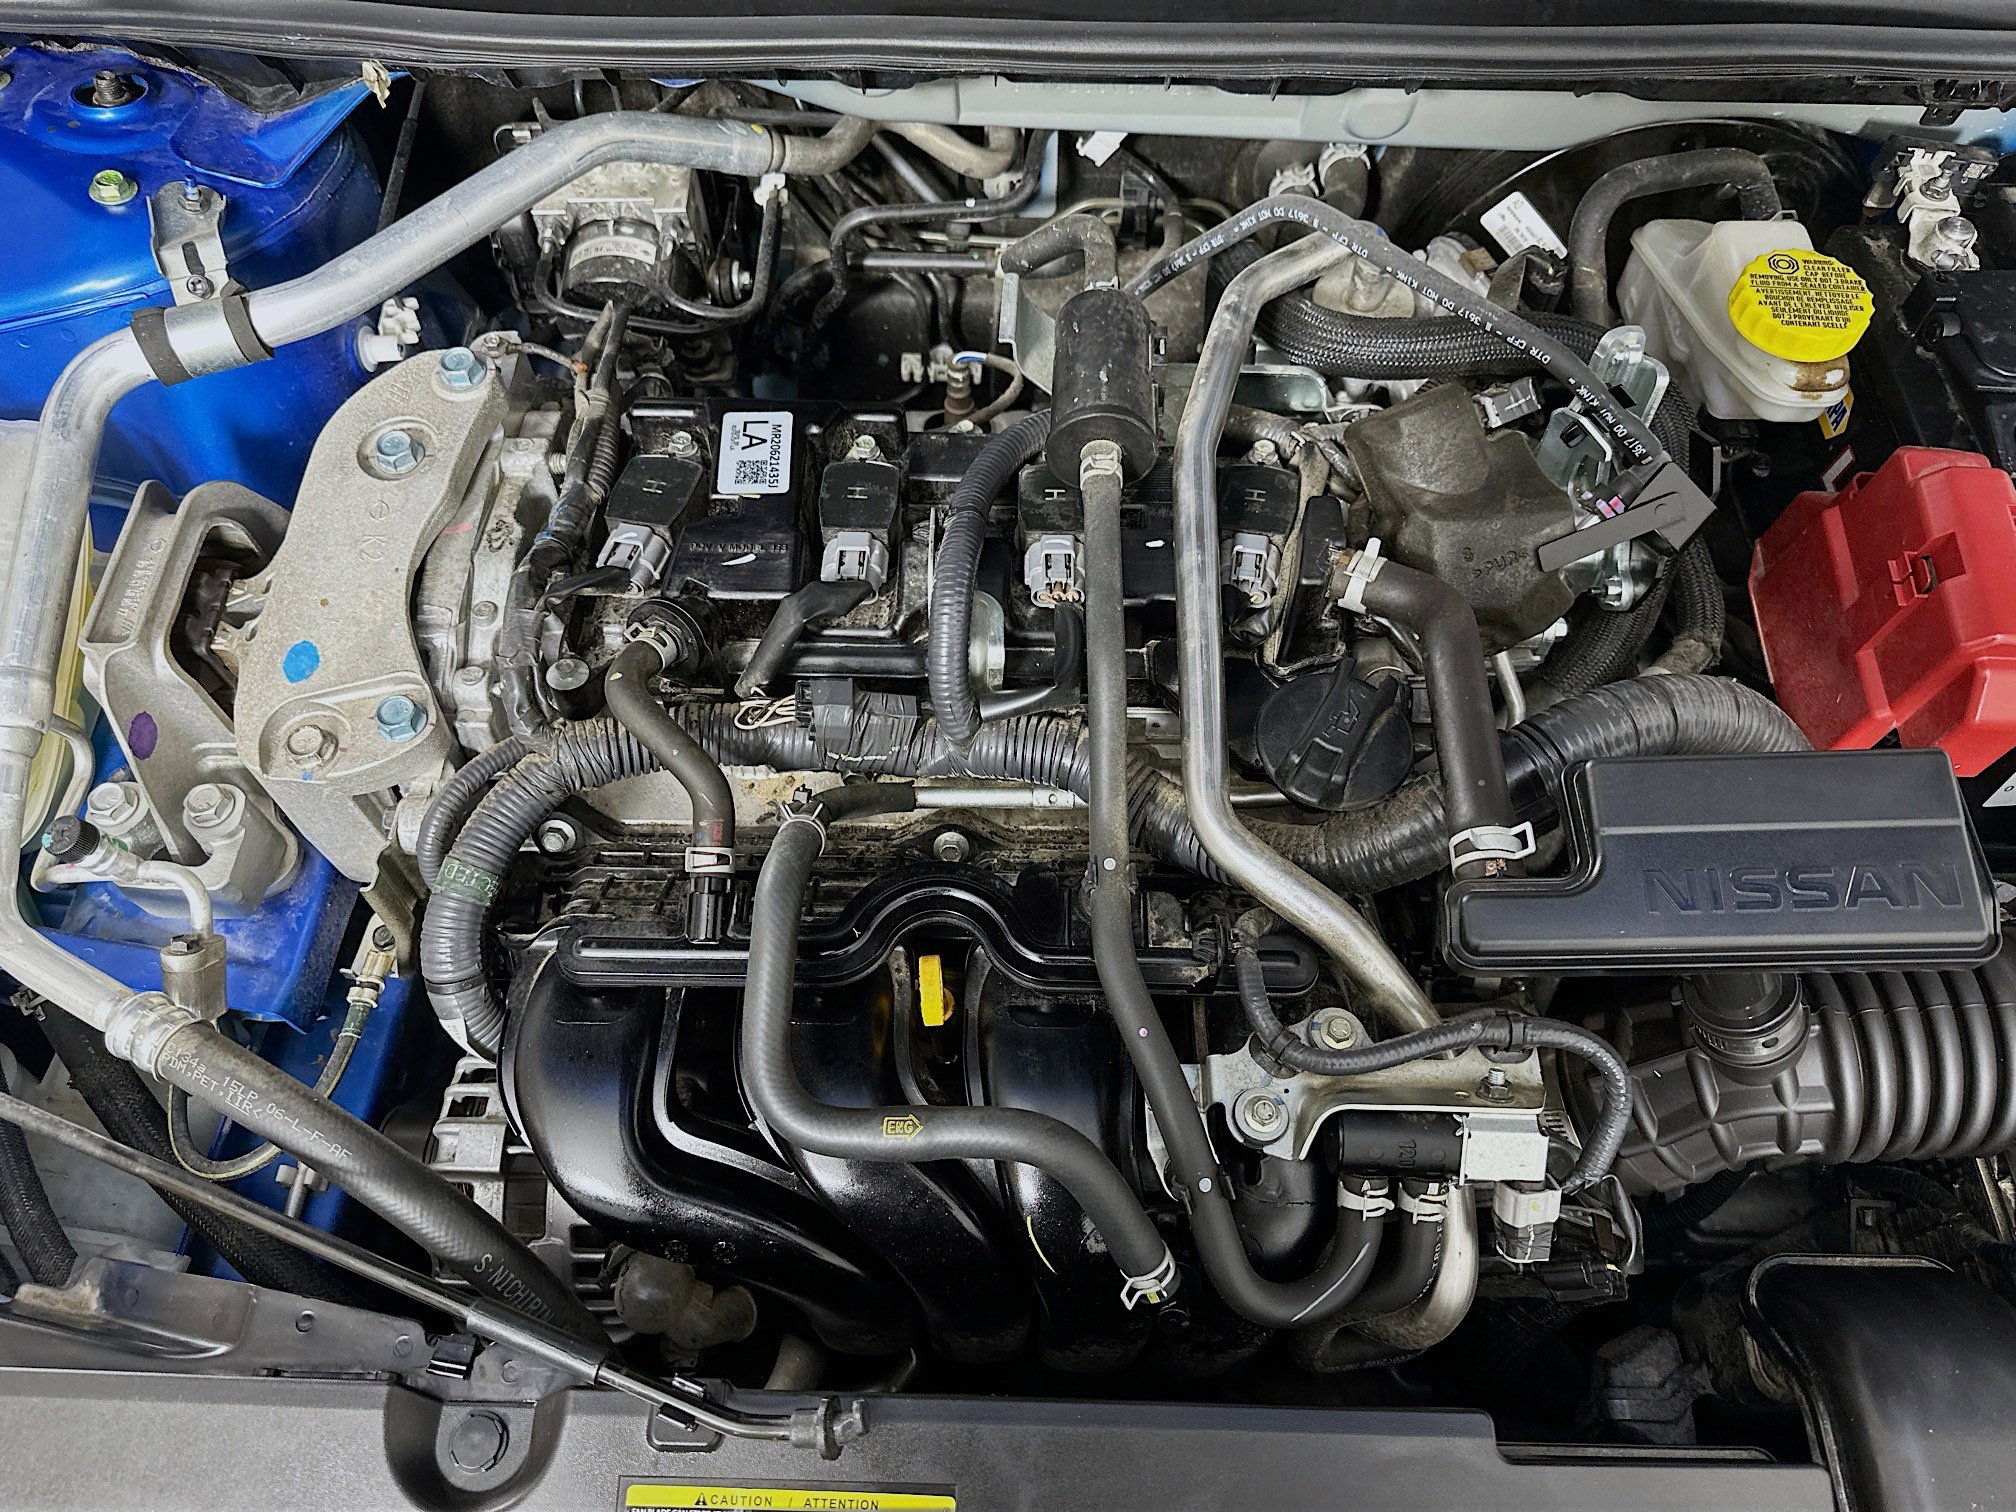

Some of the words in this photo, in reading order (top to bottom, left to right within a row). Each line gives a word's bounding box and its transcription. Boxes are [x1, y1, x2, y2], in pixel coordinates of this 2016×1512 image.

[1395, 269, 1419, 290] KINK
[1421, 286, 1440, 302] NOT
[1441, 296, 1456, 312] DO
[1771, 307, 1812, 315] SEULEMENT
[1457, 306, 1483, 327] 3617
[1780, 319, 1821, 328] CONTENANT
[1793, 314, 1834, 322] PROVENANT
[1506, 335, 1527, 350] CFP
[1529, 345, 1552, 365] DTR
[1575, 383, 1600, 407] KINK
[741, 420, 769, 450] LA
[768, 424, 783, 488] MR20621435J
[1642, 864, 1964, 915] NISSAN
[222, 1076, 260, 1100] 15LP
[887, 1120, 914, 1134] ENG
[710, 1494, 773, 1507] CAUTION
[803, 1497, 880, 1510] ATTENTION
